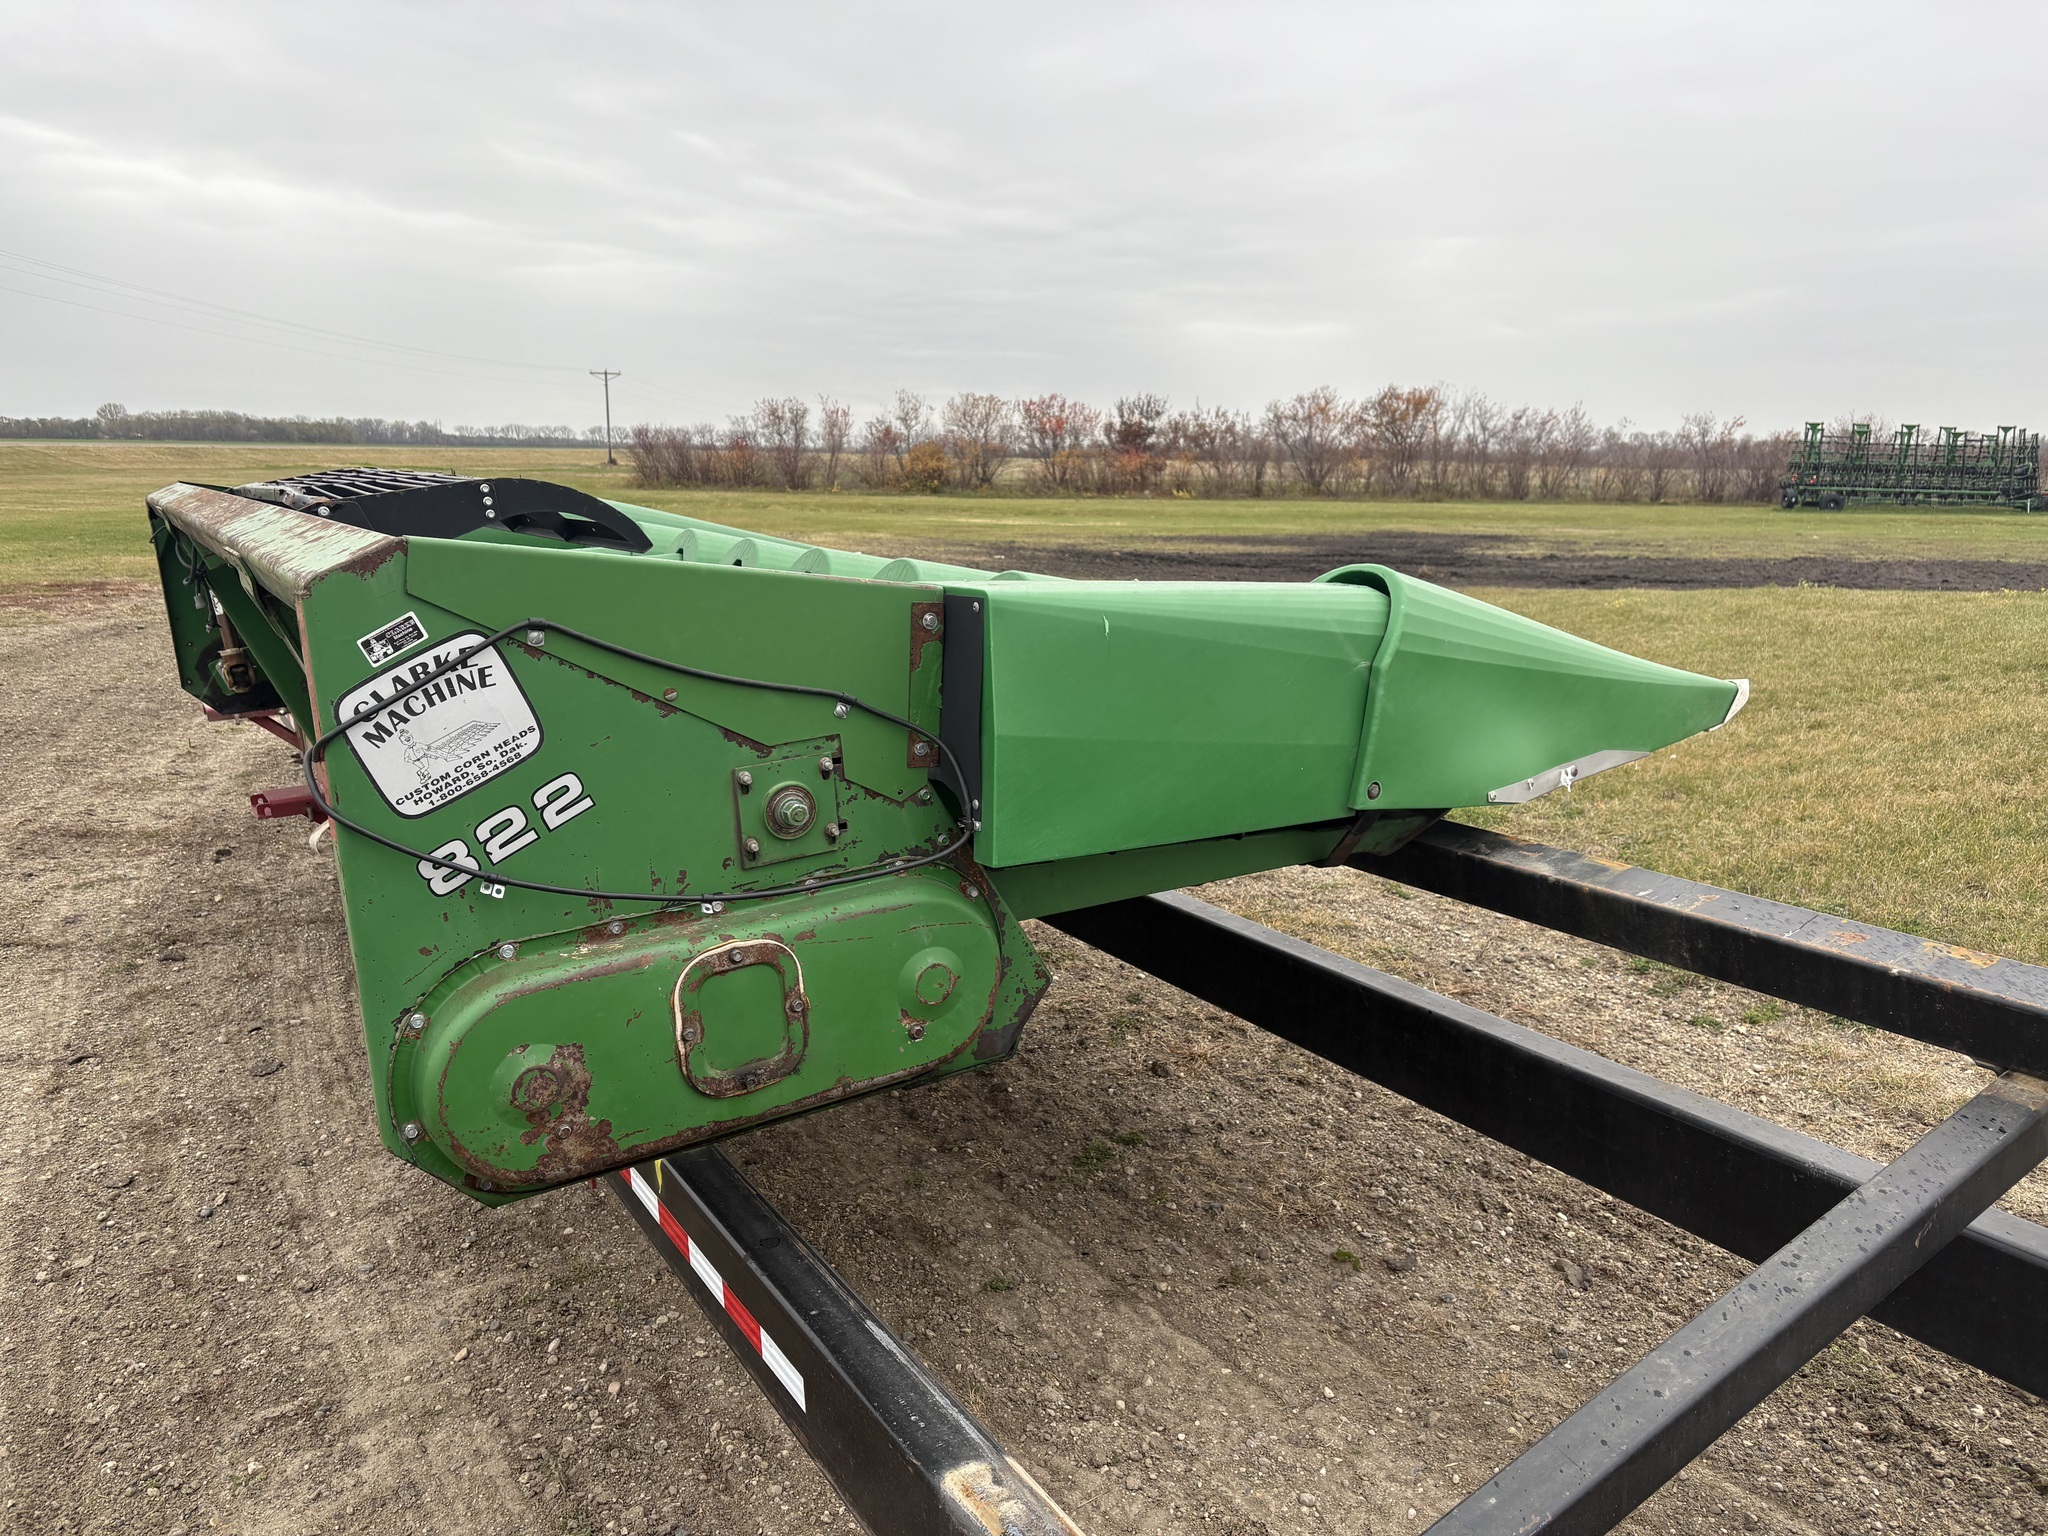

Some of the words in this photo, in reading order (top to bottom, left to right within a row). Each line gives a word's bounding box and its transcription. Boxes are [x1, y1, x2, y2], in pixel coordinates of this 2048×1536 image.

[361, 665, 497, 749] MACHINE
[395, 772, 452, 806] CUSTOM
[454, 750, 491, 774] CORN
[493, 725, 536, 752] HEADS
[413, 772, 475, 806] HOWARD,
[476, 759, 497, 771] So.
[499, 742, 528, 759] Dak.
[428, 752, 522, 806] 1-800-658-4568
[416, 771, 596, 897] 822
